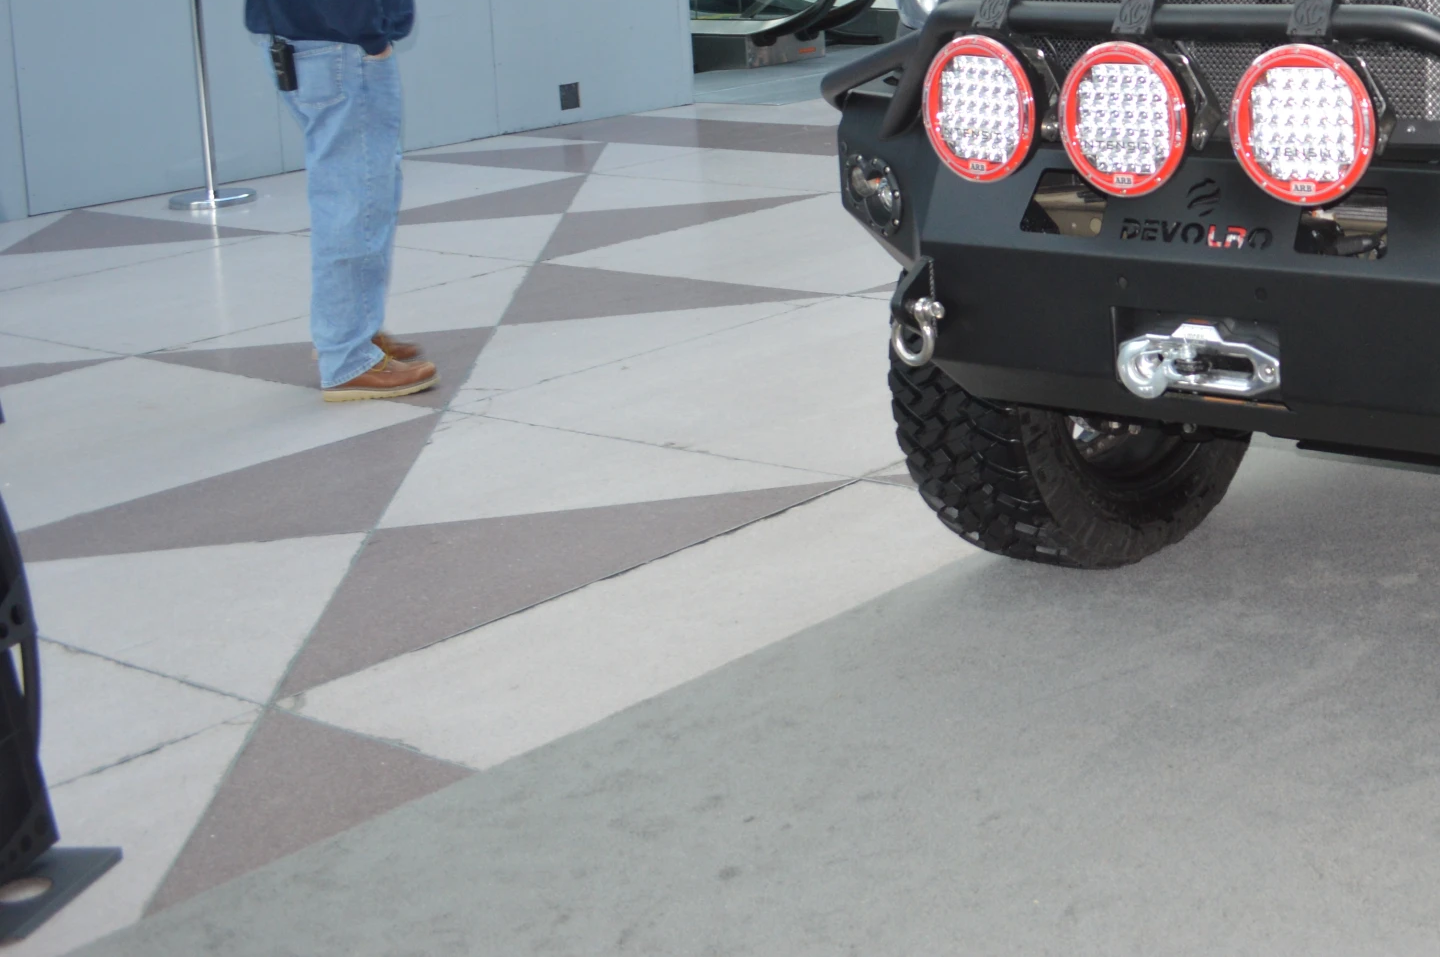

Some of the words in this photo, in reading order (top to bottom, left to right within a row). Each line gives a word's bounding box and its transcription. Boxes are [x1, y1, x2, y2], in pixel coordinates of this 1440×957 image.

[943, 126, 1003, 141] NTENSIT
[970, 163, 985, 172] ARB
[1115, 176, 1132, 186] ARB
[1293, 184, 1313, 194] ARB
[1119, 217, 1273, 251] DEVOLRO
